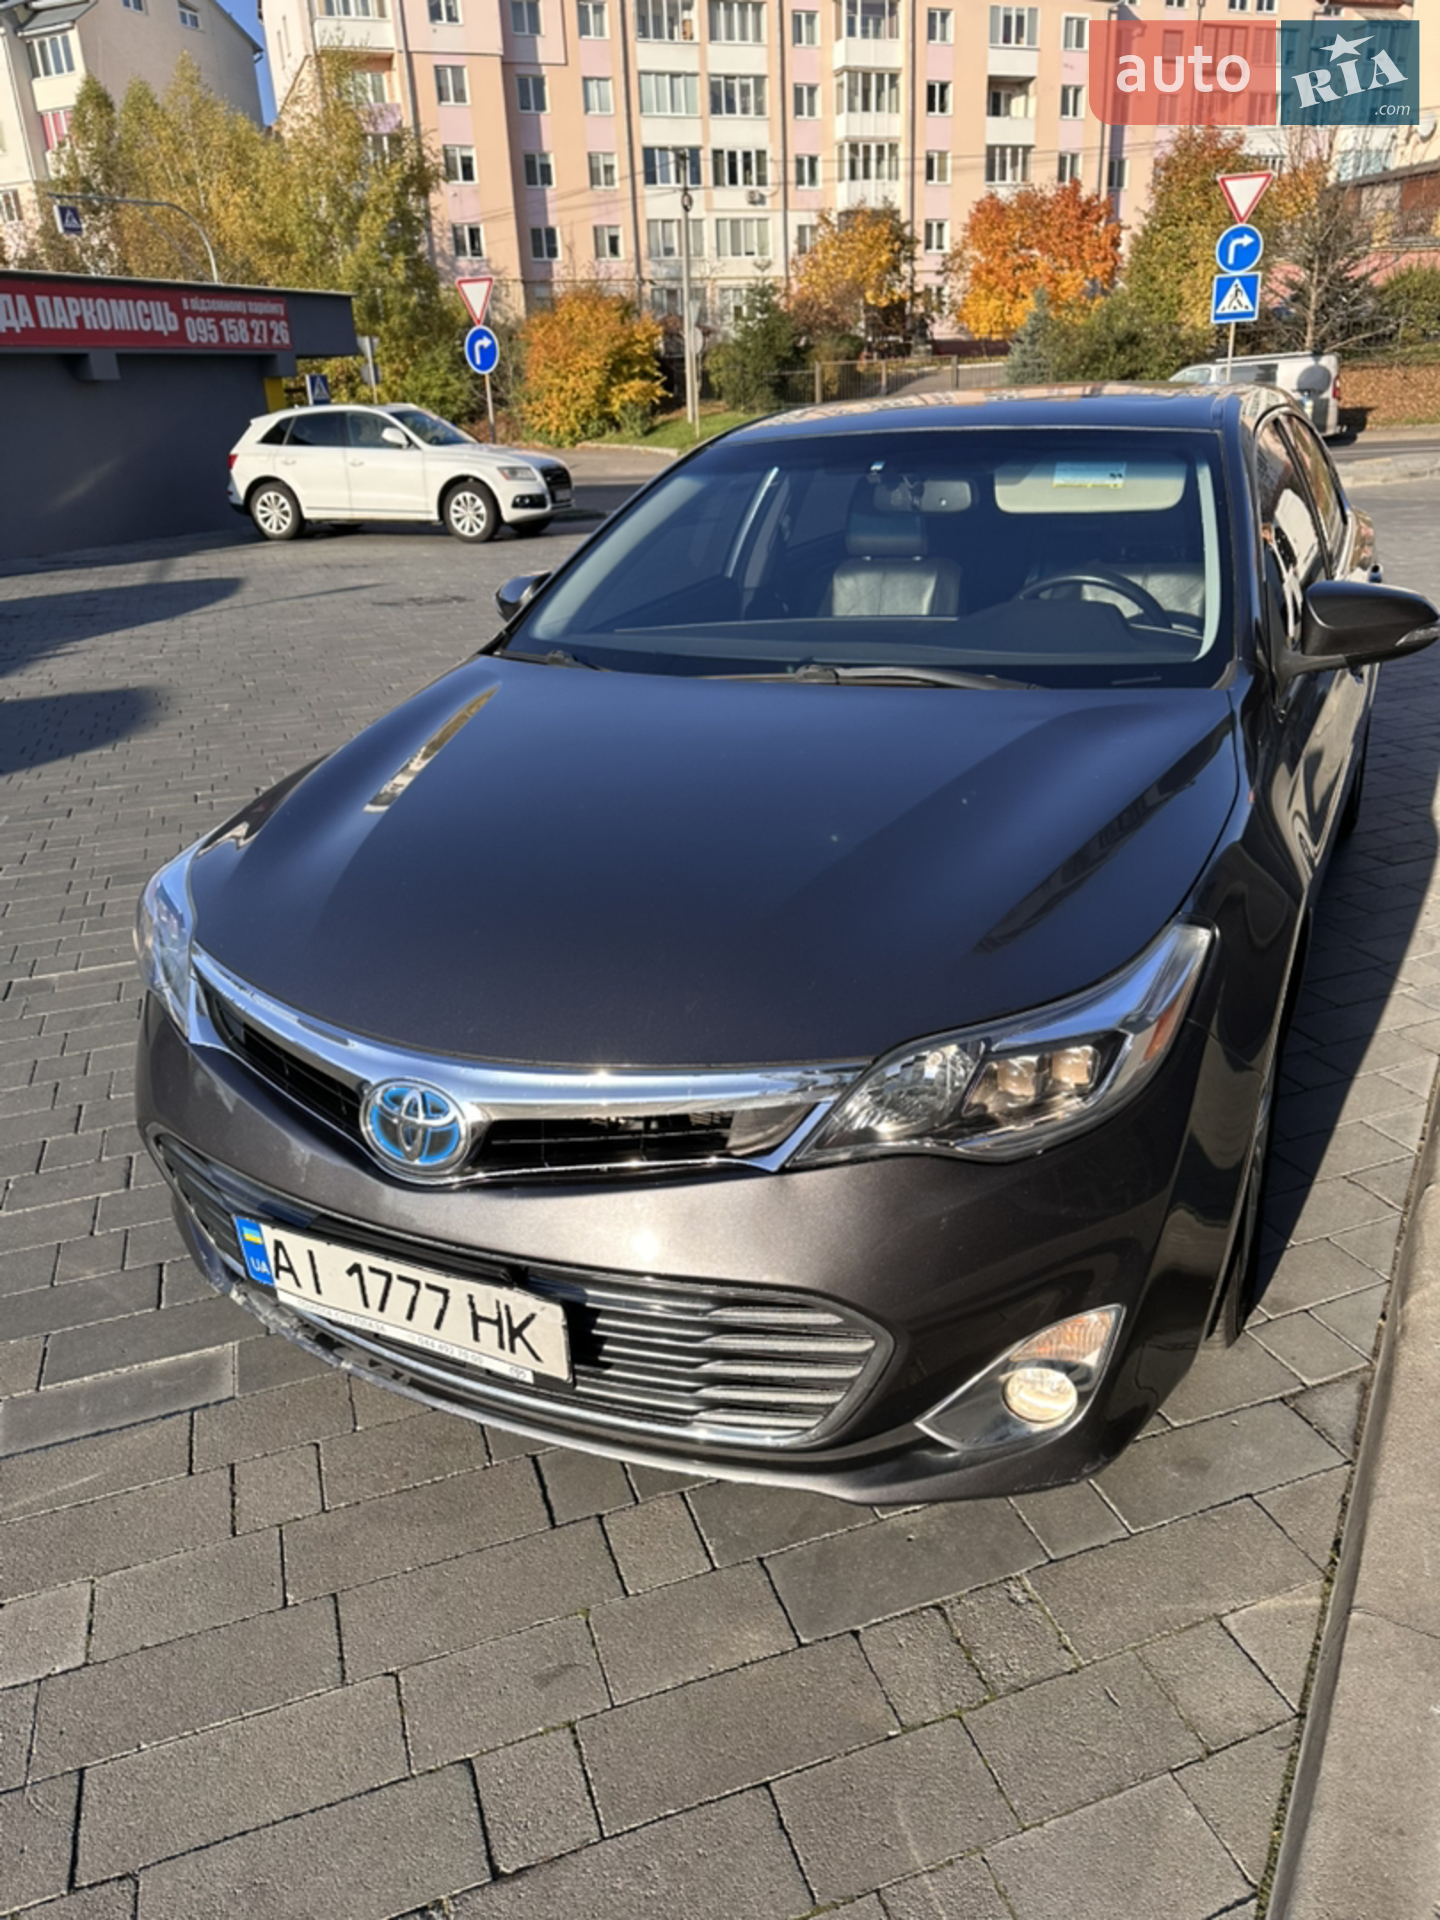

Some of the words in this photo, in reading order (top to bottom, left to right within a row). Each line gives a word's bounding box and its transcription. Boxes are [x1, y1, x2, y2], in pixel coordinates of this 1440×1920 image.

[35, 295, 179, 336] ПАРКОМІСЦЬ
[185, 316, 219, 343] 095
[220, 318, 249, 344] 158
[250, 319, 268, 344] 27
[269, 320, 290, 344] 26
[250, 1256, 270, 1275] UA
[273, 1239, 322, 1295] AI
[345, 1262, 451, 1331] 1777
[467, 1293, 544, 1364] HK
